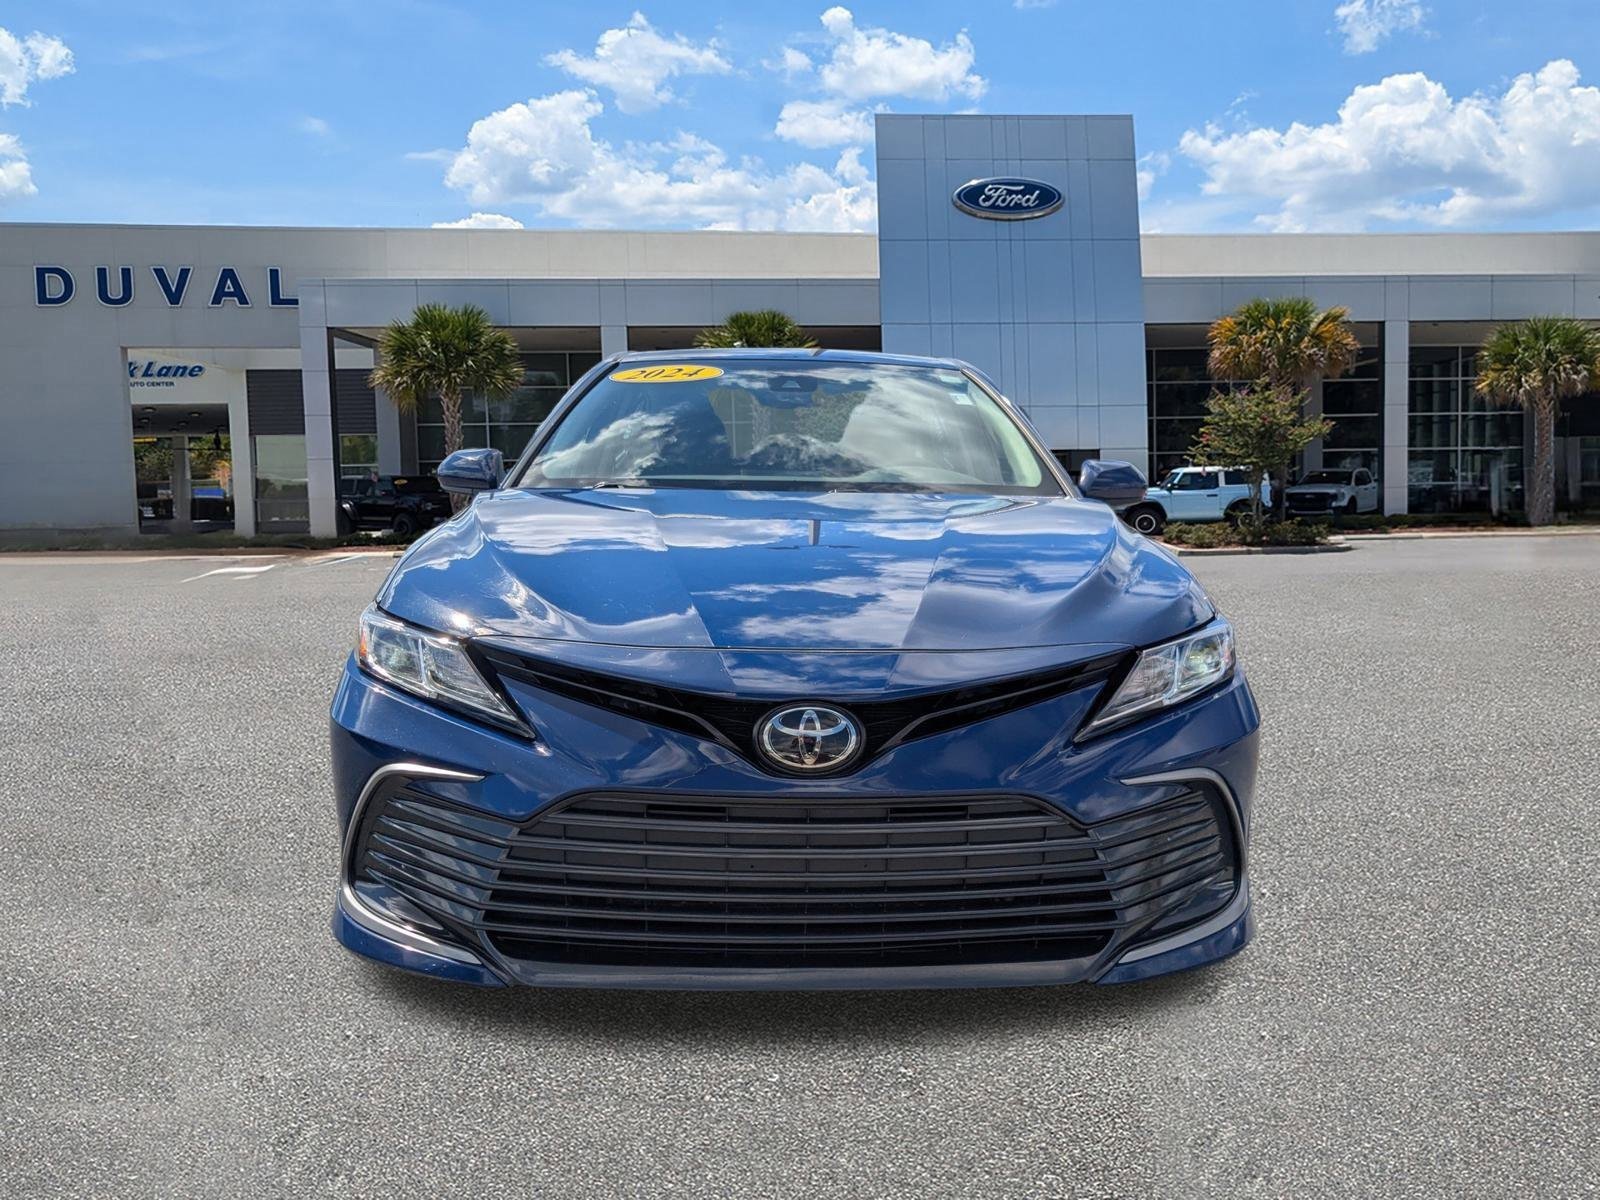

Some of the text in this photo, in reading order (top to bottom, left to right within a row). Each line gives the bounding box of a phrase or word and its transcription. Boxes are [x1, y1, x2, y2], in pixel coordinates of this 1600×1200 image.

[979, 184, 1041, 208] Ford
[33, 265, 299, 307] DUVAL
[141, 361, 205, 378] Lane
[624, 367, 706, 380] 2024
